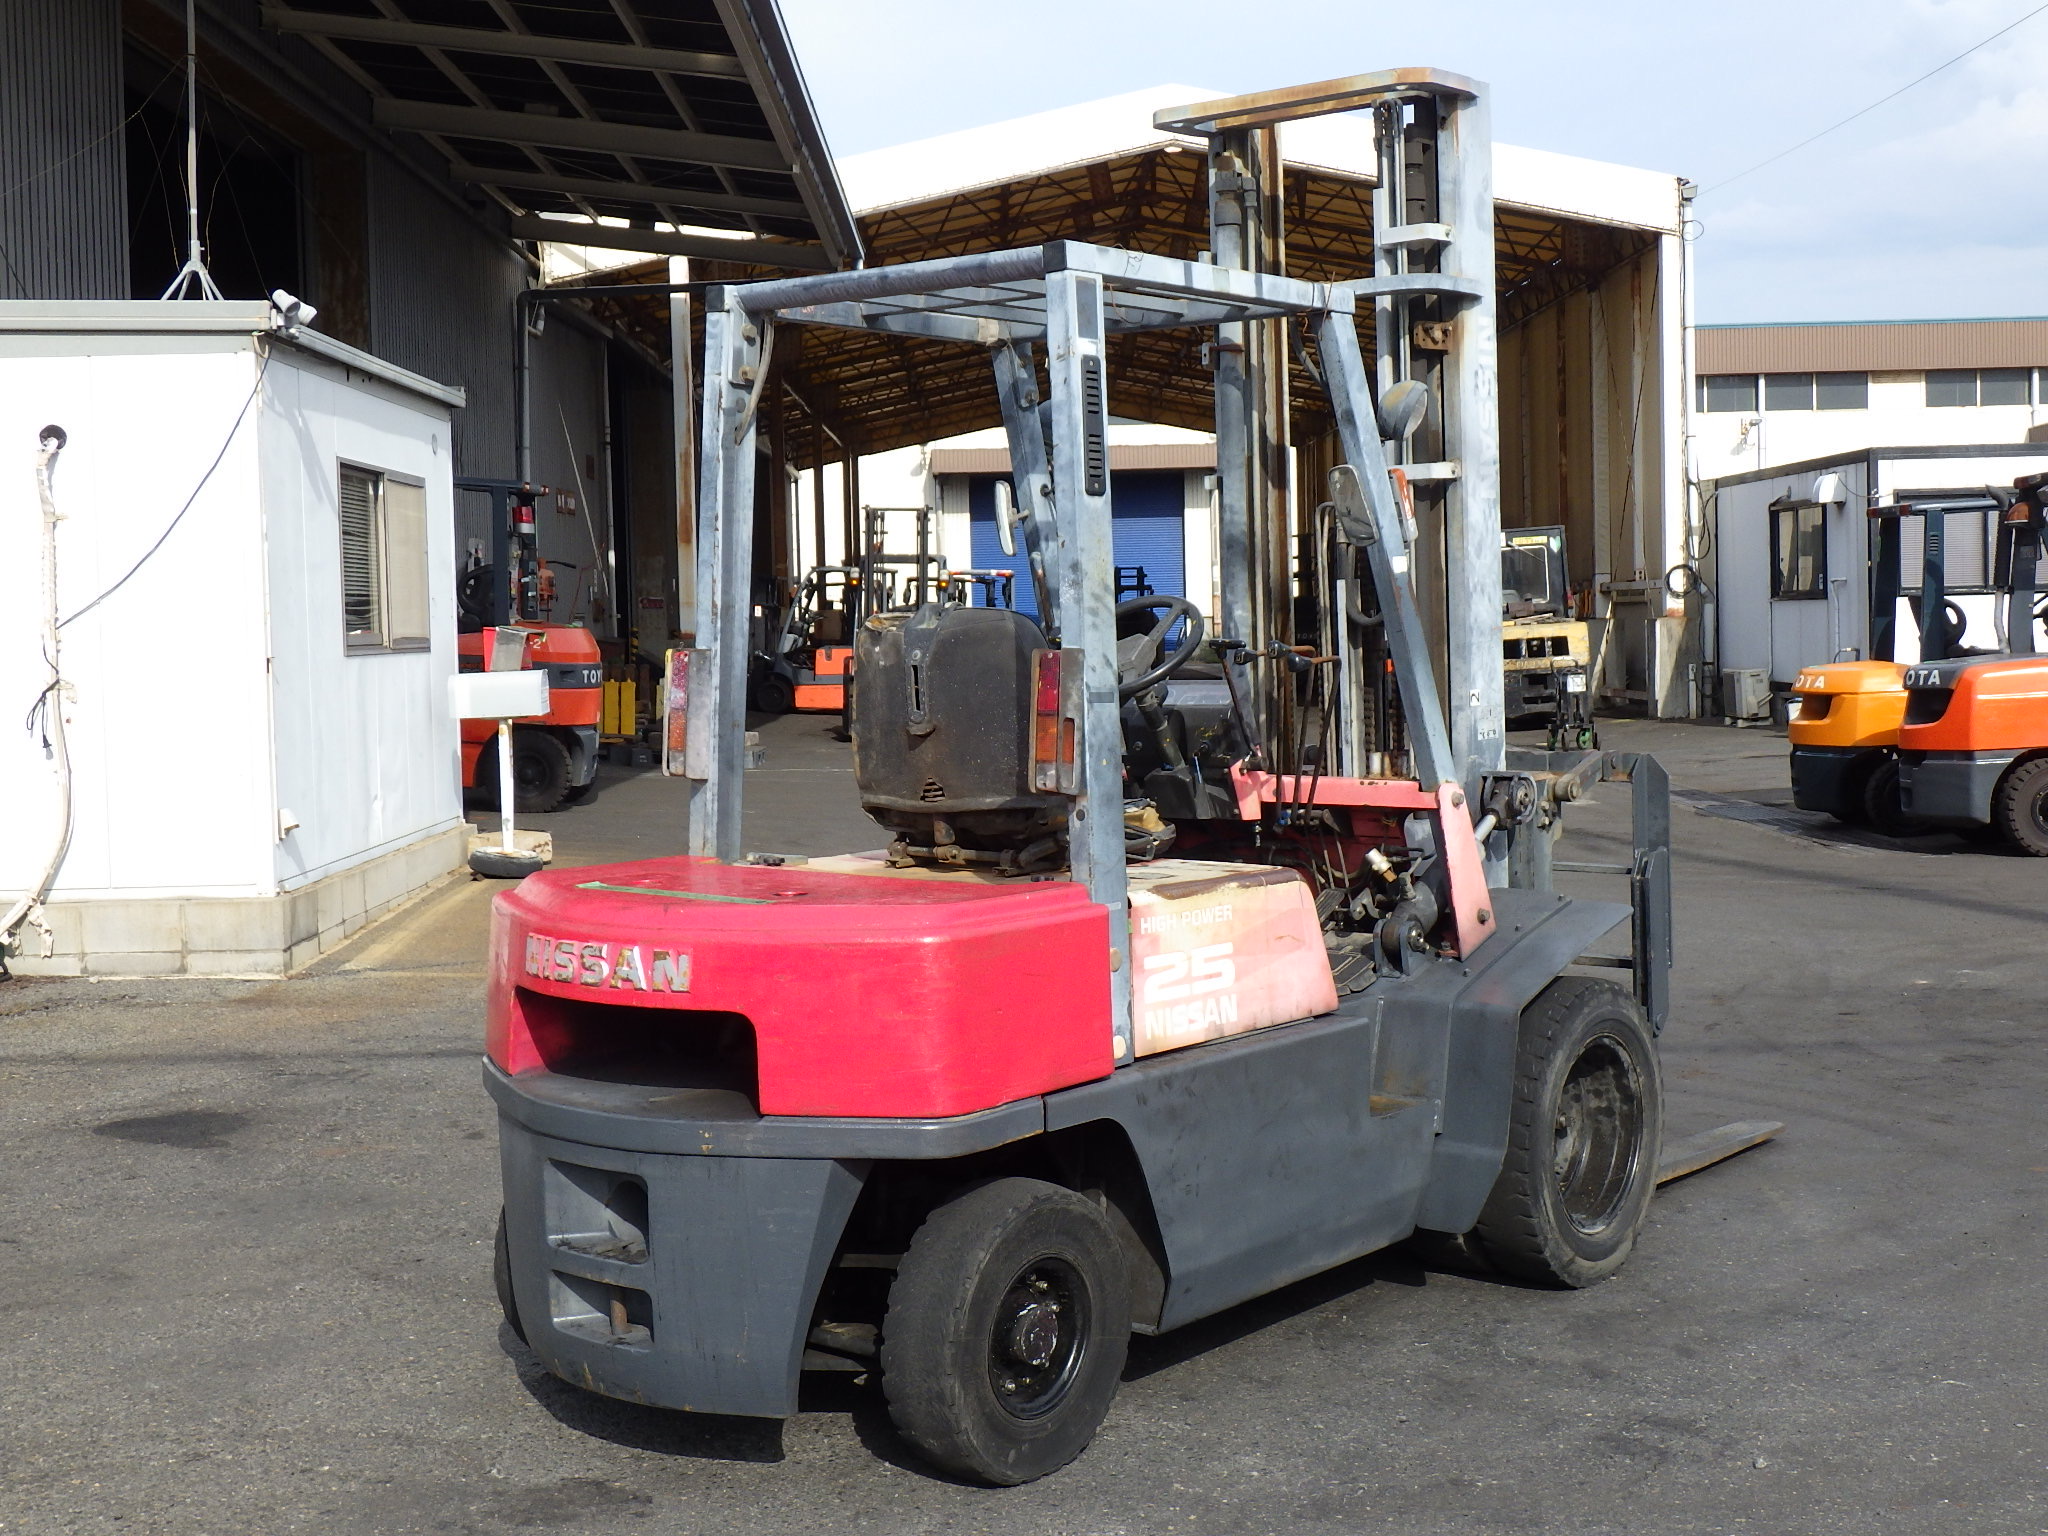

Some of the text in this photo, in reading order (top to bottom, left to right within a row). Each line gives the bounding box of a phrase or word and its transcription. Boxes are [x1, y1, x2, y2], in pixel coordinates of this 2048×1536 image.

[1477, 316, 1497, 500] NISSAN
[1795, 674, 1825, 689] OTA
[1906, 669, 1940, 686] OTA
[1141, 904, 1233, 935] HIGH POWER
[525, 932, 693, 993] NISSAN
[1143, 942, 1236, 1005] 25
[1144, 993, 1238, 1040] NISSAN
